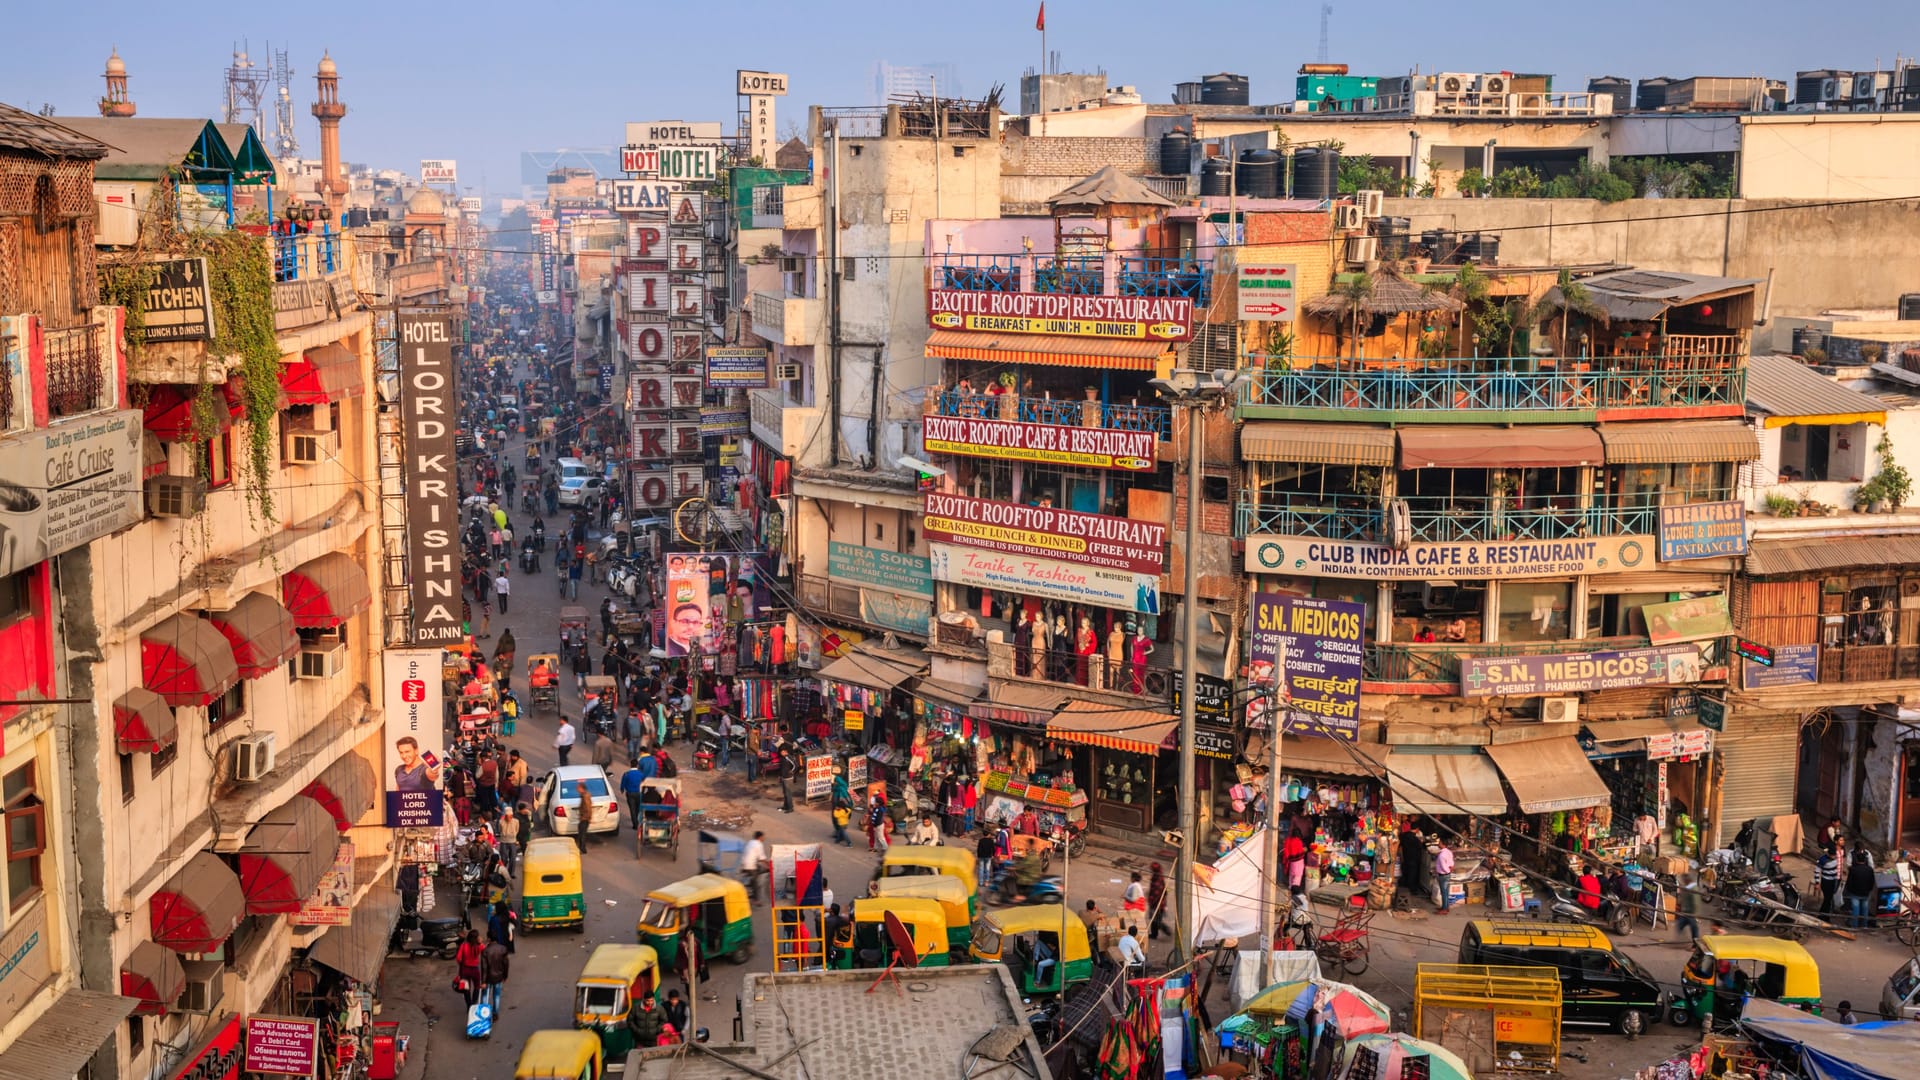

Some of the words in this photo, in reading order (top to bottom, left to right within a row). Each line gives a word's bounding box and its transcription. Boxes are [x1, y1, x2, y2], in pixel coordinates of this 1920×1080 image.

[651, 127, 694, 139] HOTEL
[660, 150, 714, 178] HOTEL
[617, 186, 680, 208] HAR
[272, 284, 300, 312] EVEREST
[931, 290, 987, 313] EXOTIC
[991, 294, 1068, 316] ROOFTOP
[1072, 297, 1188, 320] RESTAURANT
[148, 328, 170, 337] LUNCH
[173, 327, 178, 336] &
[180, 326, 205, 335] DINNER
[404, 322, 448, 342] HOTEL
[974, 317, 1031, 330] BREAKFAST
[1046, 321, 1080, 333] LUNCH
[1096, 322, 1137, 336] DINNER
[413, 348, 446, 439] LORD
[46, 436, 60, 449] Roof
[61, 432, 72, 448] Top
[926, 418, 966, 442] EXOTIC
[969, 422, 1022, 447] ROOFTOP
[1026, 426, 1056, 450] CAFE
[1059, 428, 1068, 451] &
[1071, 430, 1152, 458] RESTAURANT
[46, 451, 74, 486] Café
[78, 446, 114, 476] Cruise
[926, 494, 979, 520] EXOTIC
[982, 503, 1054, 530] ROOFTOP
[1057, 513, 1165, 546] RESTAURANT
[1664, 504, 1742, 524] BREAKFAST
[418, 454, 454, 622] KRISHNA
[927, 518, 987, 535] BREAKFAST
[990, 527, 1026, 541] LUNCH
[1028, 534, 1037, 543] &
[1040, 536, 1083, 550] DINNER
[1089, 542, 1123, 556] (FREE
[1126, 548, 1163, 564] WI-FI)
[1665, 526, 1694, 541] LUNCH
[1697, 526, 1704, 538] &
[1707, 523, 1742, 536] DINNER
[838, 545, 875, 559] HIRA
[880, 553, 924, 569] SONS
[953, 535, 995, 548] REMEMBER
[1008, 544, 1023, 552] FOR
[1025, 545, 1066, 559] DELICIOUS
[1068, 552, 1090, 562] FOOD
[1091, 555, 1130, 569] SERVICES
[1309, 544, 1354, 563] CLUB
[1361, 548, 1410, 565] INDIA
[1416, 547, 1461, 565] CAFE
[1468, 547, 1479, 564] &
[1486, 543, 1596, 564] RESTAURANT
[1676, 541, 1734, 556] ENTRANCE
[837, 564, 859, 572] READY
[862, 568, 881, 576] MADE
[883, 572, 924, 585] GARMENTS
[964, 552, 1015, 574] Tanika
[1022, 561, 1087, 585] Fashion
[1322, 564, 1356, 574] INDIAN
[1366, 566, 1438, 576] CONTINENTAL
[1448, 566, 1492, 576] CHINESE
[1506, 565, 1554, 574] JAPANESE
[1558, 563, 1584, 572] FOOD
[1000, 575, 1020, 583] Fashion
[1042, 581, 1069, 590] Garments
[1070, 585, 1084, 594] Belly
[1085, 588, 1102, 596] Dance
[1104, 590, 1124, 599] Dresses
[1258, 604, 1287, 631] S.N.
[1292, 607, 1360, 640] MEDICOS
[1263, 634, 1297, 646] CHEMIST
[1323, 641, 1362, 654] SERGICAL
[1785, 646, 1813, 654] TUITION
[1286, 660, 1326, 672] COSMETIC
[1322, 652, 1360, 665] MEDICINE
[408, 661, 419, 678] trip
[1487, 664, 1536, 683] S.N.
[1544, 657, 1649, 680] MEDICOS
[408, 682, 423, 700] my
[1292, 676, 1359, 695] दवाईयाँ
[1496, 684, 1535, 694] CHEMIST
[1545, 680, 1592, 691] PHARMACY
[1602, 677, 1642, 688] COSMETIC
[277, 1022, 309, 1031] EXCHANGE
[254, 1046, 277, 1055] Обмен
